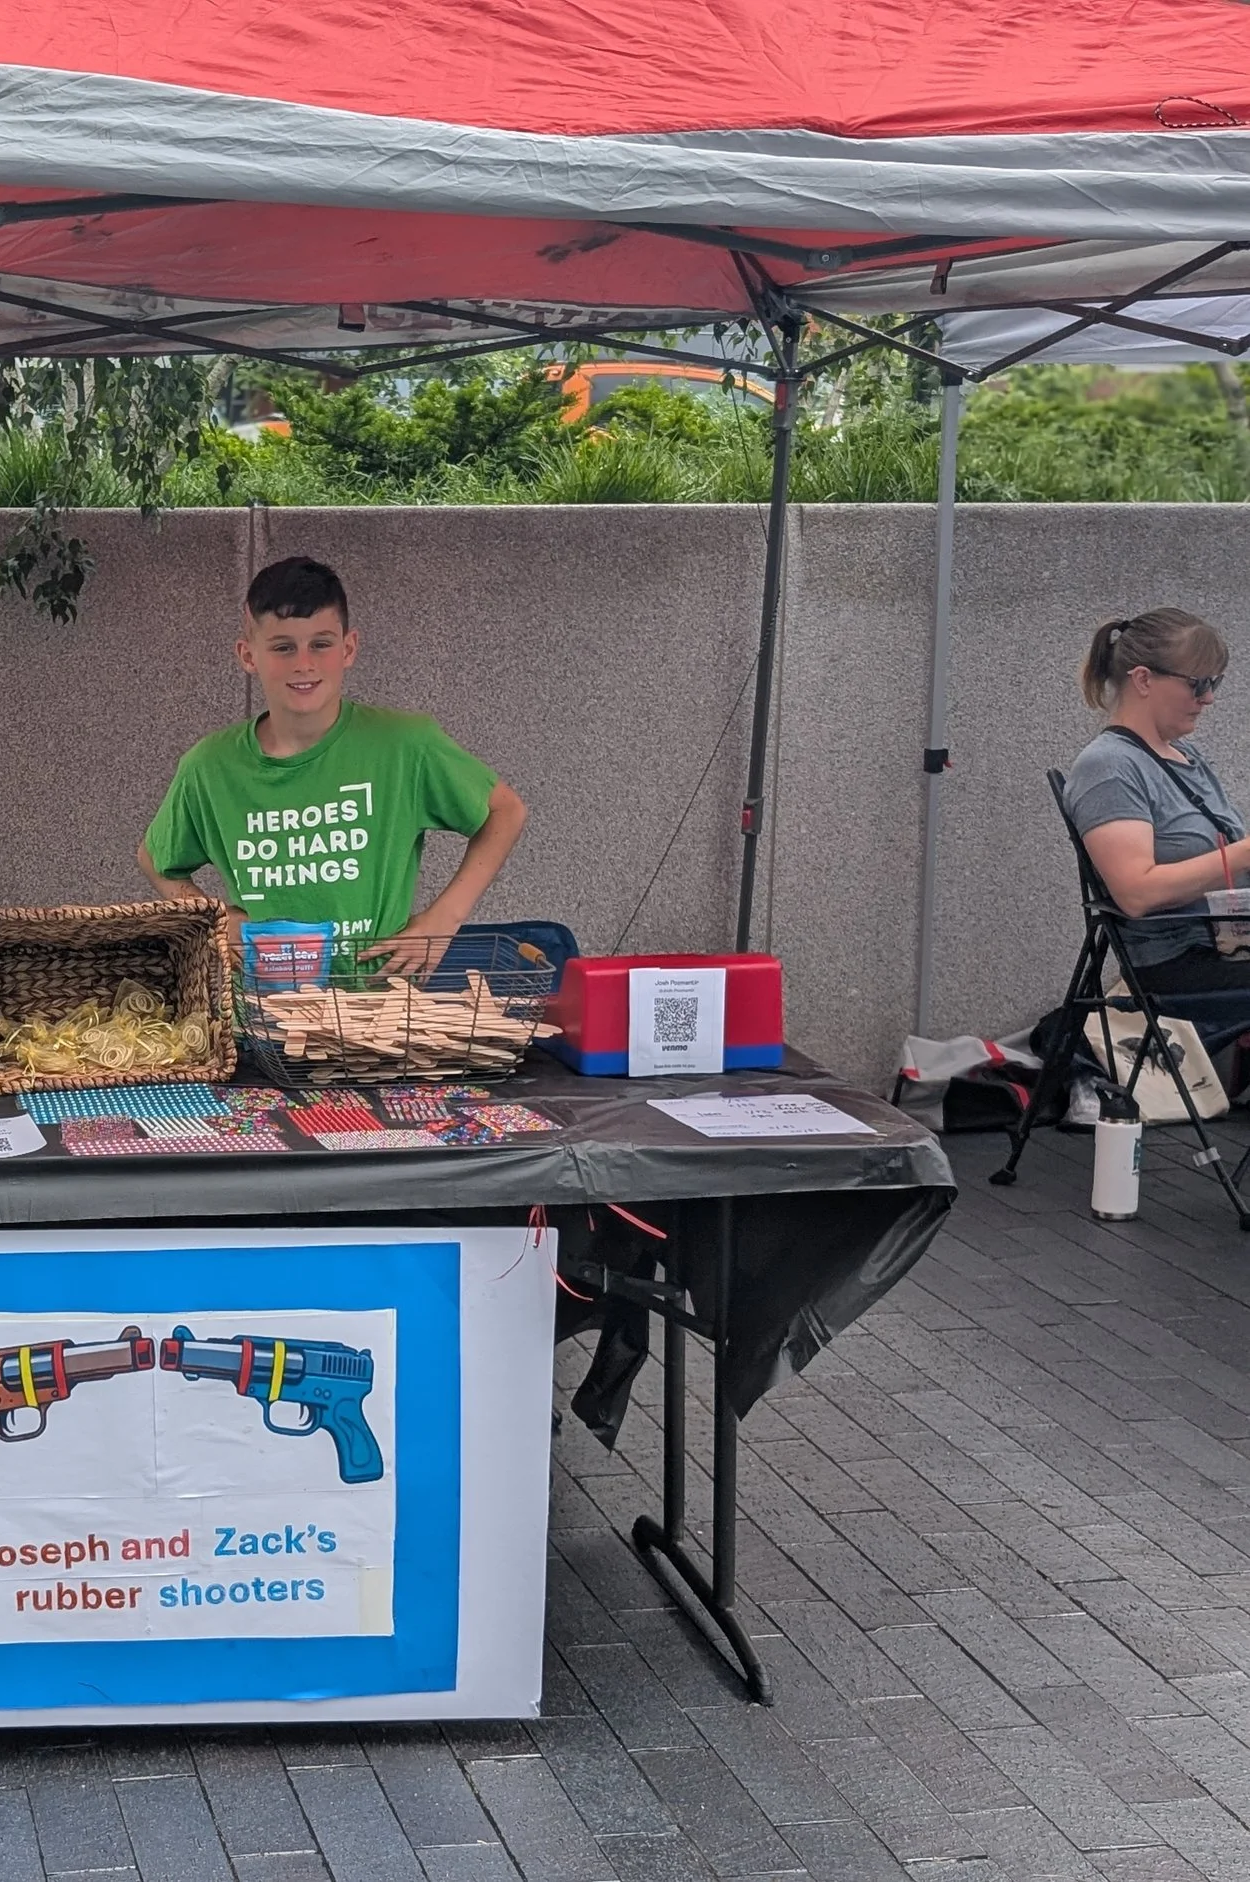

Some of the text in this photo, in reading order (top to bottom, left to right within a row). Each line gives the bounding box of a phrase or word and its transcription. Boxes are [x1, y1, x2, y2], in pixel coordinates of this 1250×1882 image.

[247, 800, 359, 833] HEROES
[237, 828, 369, 861] DO HARD
[247, 858, 360, 888] THINGS
[332, 918, 372, 937] DEMY
[120, 1528, 191, 1561] and
[213, 1523, 337, 1557] Zack's
[16, 1576, 325, 1612] rubber shooters
